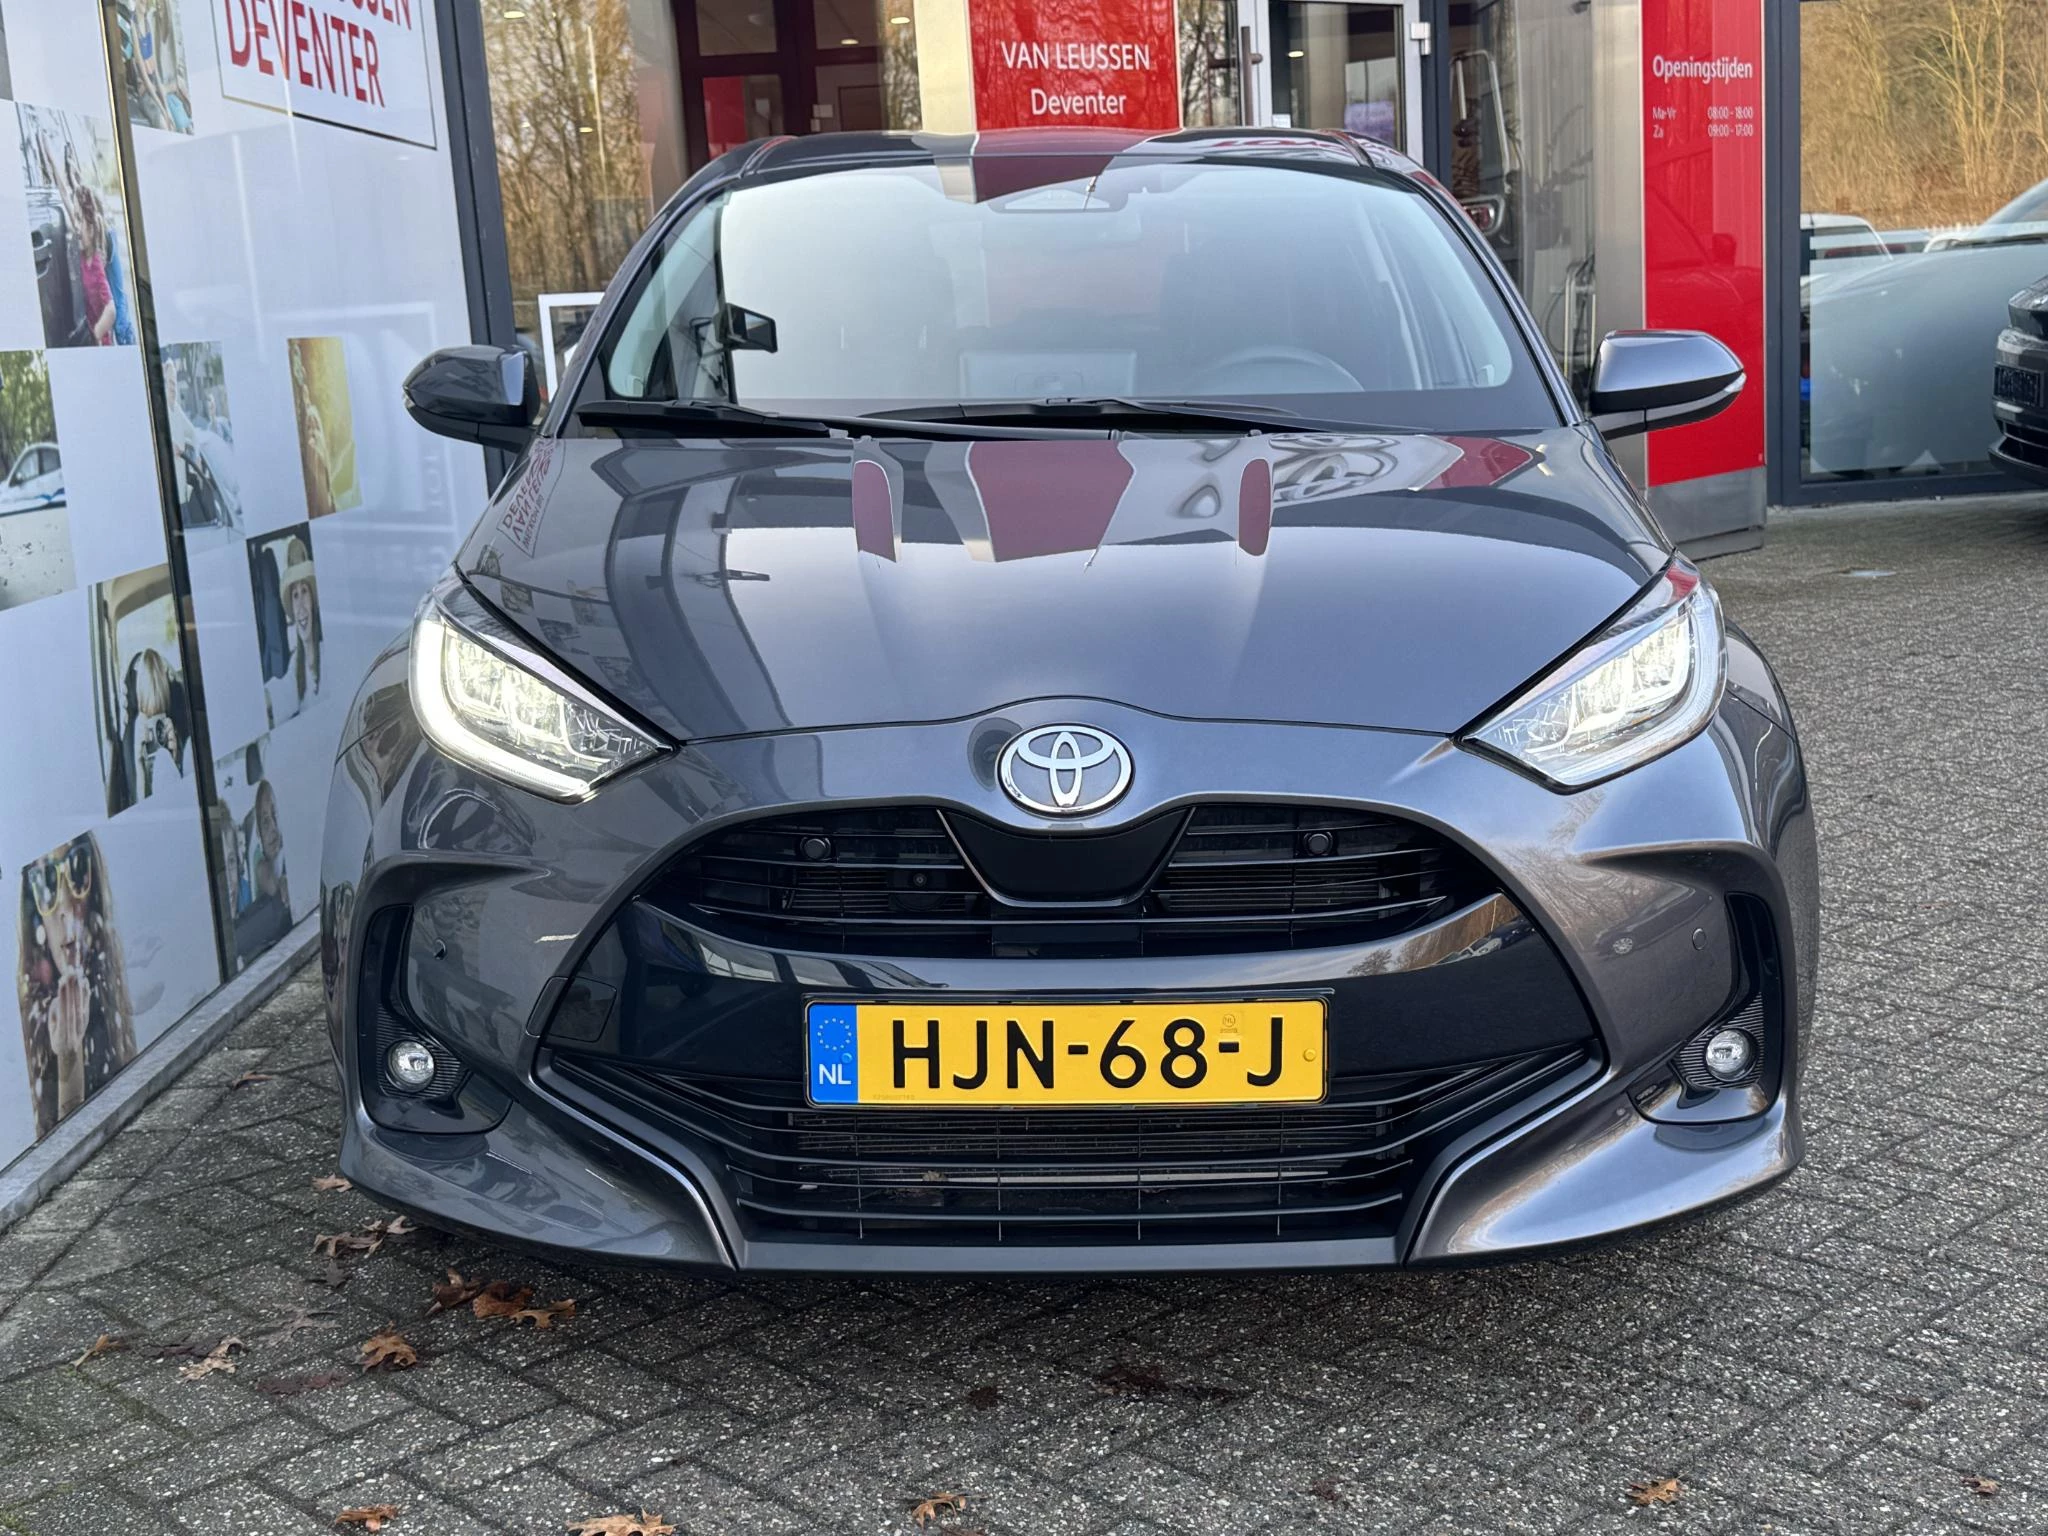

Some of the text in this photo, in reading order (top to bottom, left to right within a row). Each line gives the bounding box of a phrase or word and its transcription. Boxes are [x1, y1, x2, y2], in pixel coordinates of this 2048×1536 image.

[225, 0, 385, 108] DEVENTER
[1001, 41, 1150, 70] VAN LEUSSEN
[1653, 55, 1753, 84] Openingstijden
[1031, 88, 1126, 115] Deventer
[819, 1017, 1283, 1090] NL HJN-68-J
